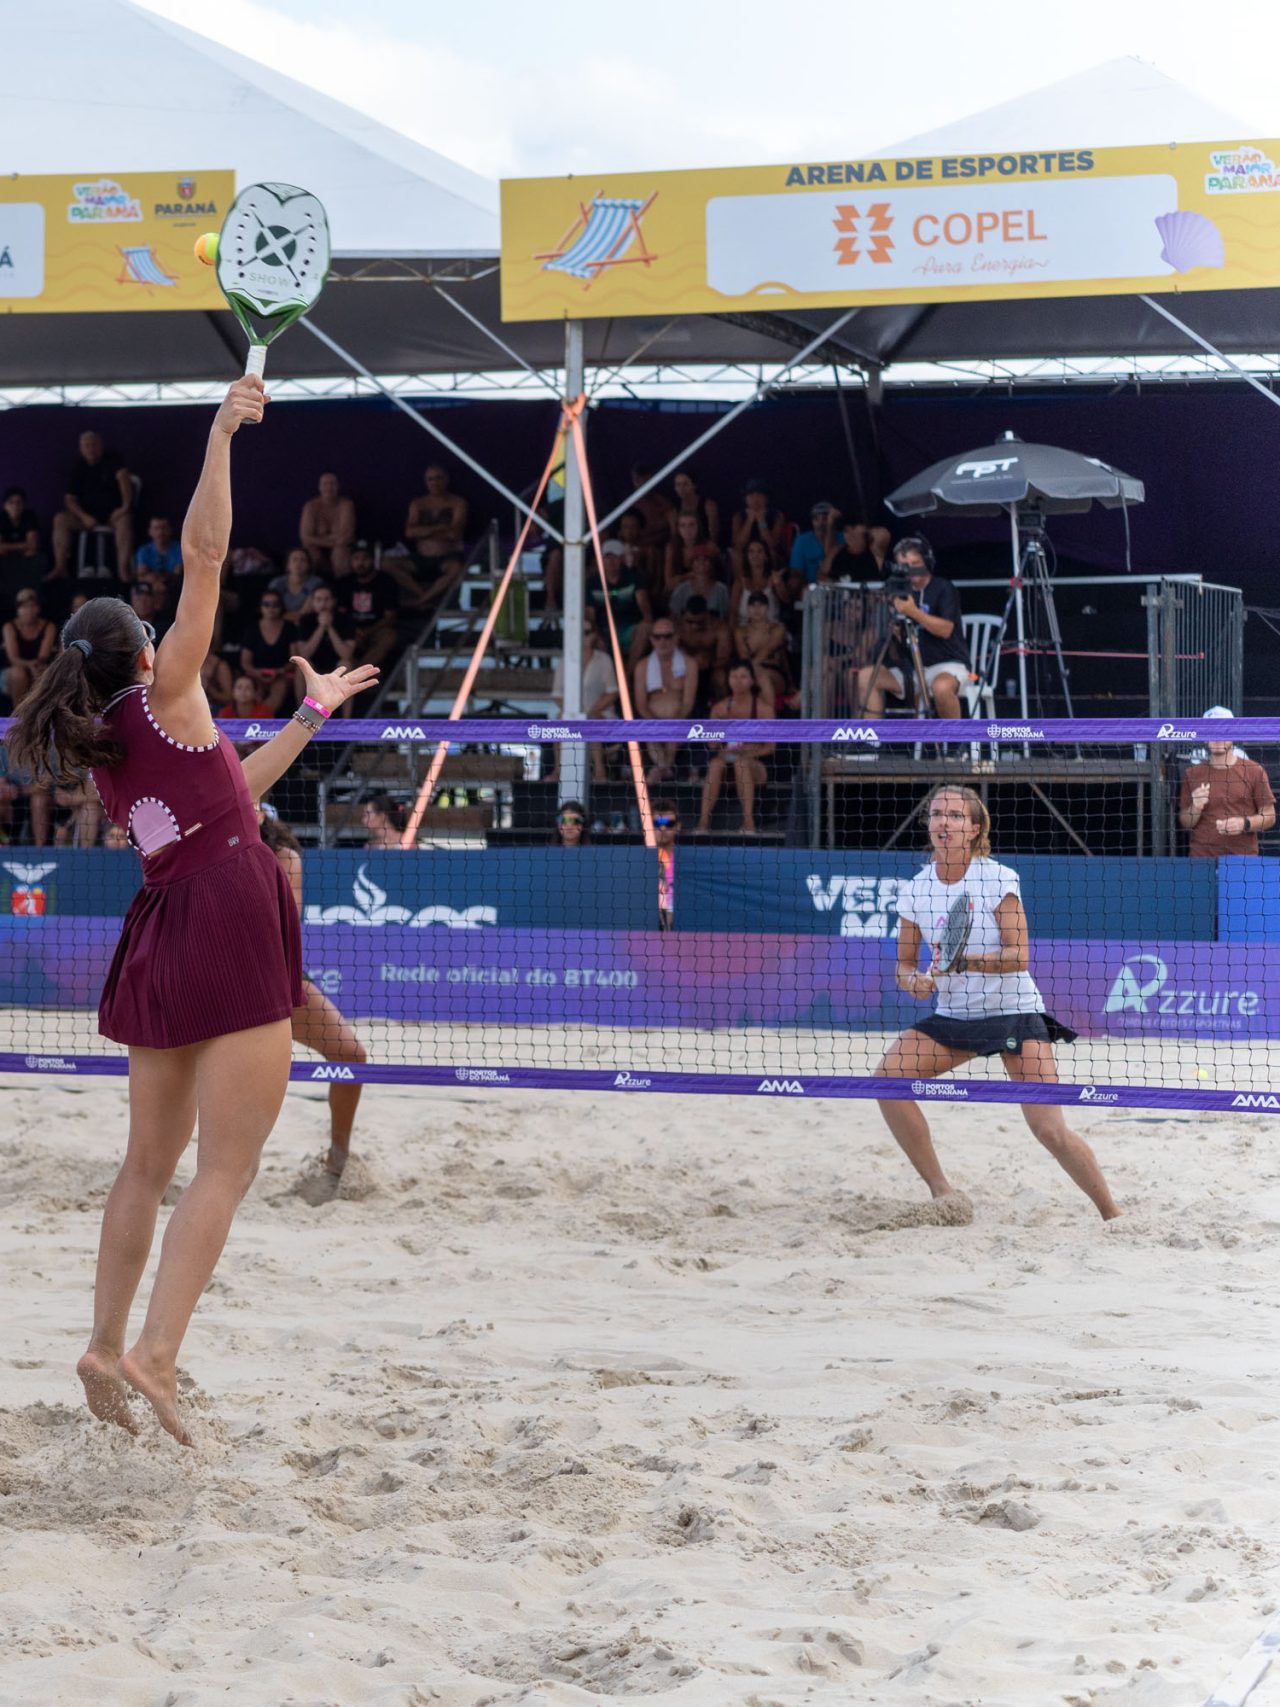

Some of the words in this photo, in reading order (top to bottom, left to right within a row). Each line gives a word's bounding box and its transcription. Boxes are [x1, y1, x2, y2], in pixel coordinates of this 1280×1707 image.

[785, 162, 887, 187] ARENA
[896, 160, 933, 181] DE
[942, 150, 1095, 179] ESPORTES
[154, 201, 217, 215] PARANÁ
[913, 209, 1048, 247] COPEL
[380, 963, 440, 982] Rede
[447, 964, 519, 985] oficial
[564, 968, 638, 989] BT400
